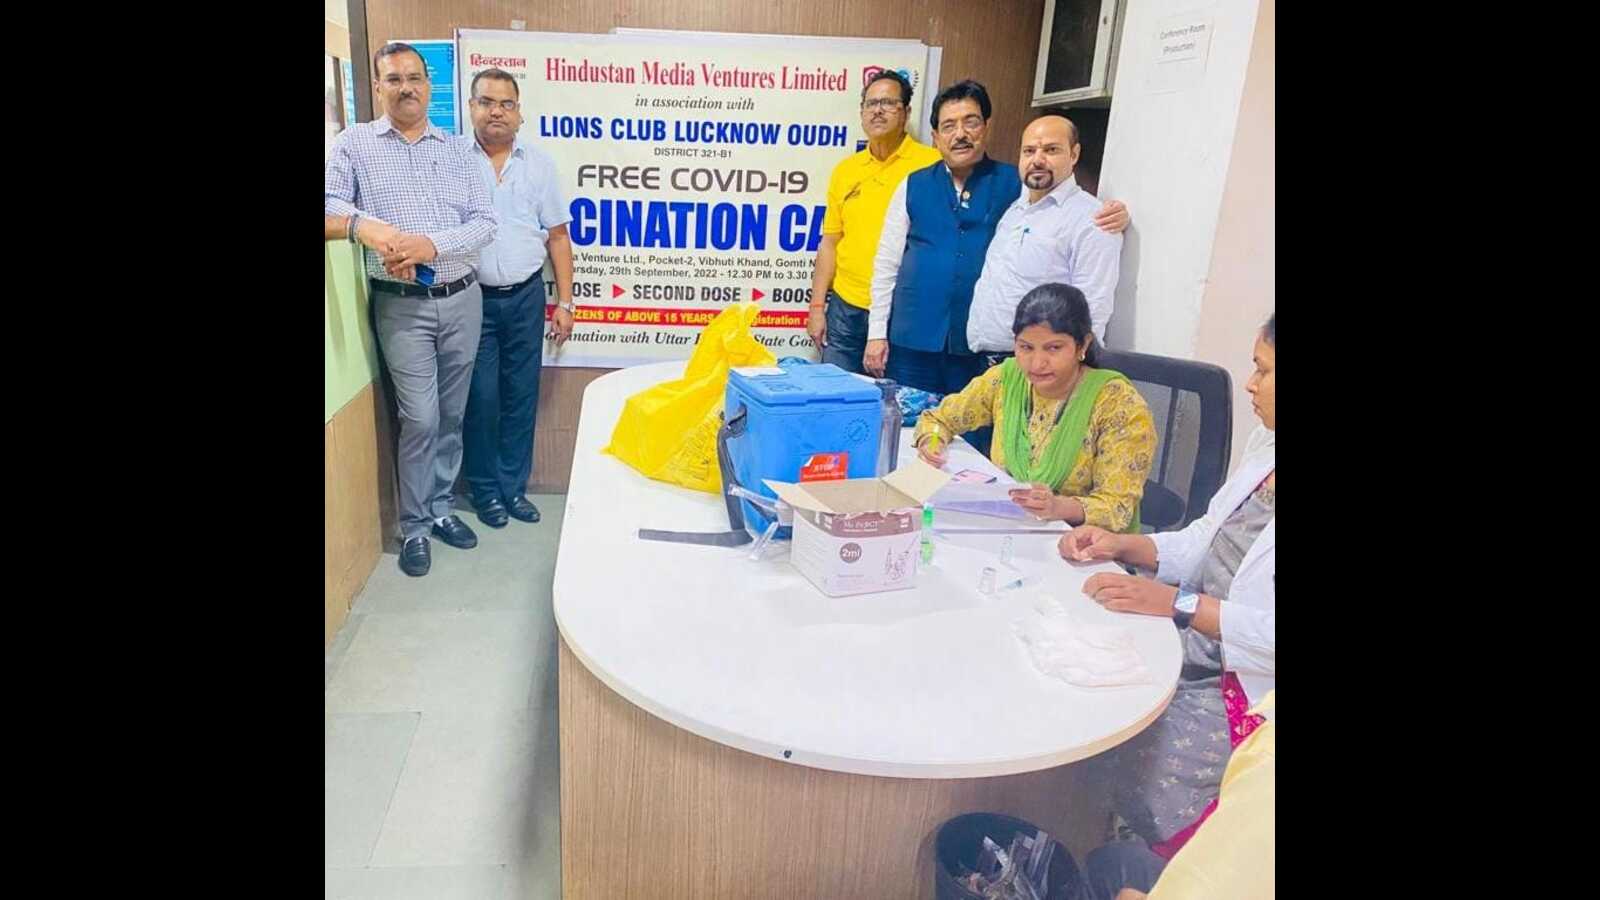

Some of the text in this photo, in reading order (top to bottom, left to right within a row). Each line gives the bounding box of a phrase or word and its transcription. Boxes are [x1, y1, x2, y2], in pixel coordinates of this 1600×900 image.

[546, 57, 848, 91] Hindustan Media Ventures Limited
[635, 94, 755, 111] in association with
[540, 115, 848, 147] LIONS CLUB LUCKNOW OUDH
[654, 147, 732, 158] DISTRICT 321-B1
[577, 164, 809, 194] FREE COVID-19
[569, 197, 827, 252] CINATION CA
[581, 252, 620, 263] Venture
[623, 254, 645, 265] Ltd.,
[648, 255, 695, 267] Pocket-2,
[699, 256, 734, 267] Vibhuti
[737, 257, 772, 268] Khand,
[776, 258, 806, 268] Gomti
[609, 266, 631, 276] 29th
[634, 267, 691, 278] September,
[694, 269, 717, 279] 2022
[727, 270, 753, 279] 12.30
[756, 270, 771, 279] PM
[774, 271, 784, 280] to
[787, 271, 807, 280] 3.30
[572, 282, 601, 297] OSE
[633, 284, 695, 300] SECOND
[701, 287, 741, 302] DOSE
[607, 311, 622, 321] OF
[624, 311, 660, 322] ABOVE
[664, 313, 677, 322] 15
[681, 312, 715, 323] YEARS
[752, 314, 801, 326] gistration
[620, 331, 649, 344] with
[655, 332, 691, 345] Uttar
[754, 334, 785, 347] State
[842, 548, 860, 558] 2ml
